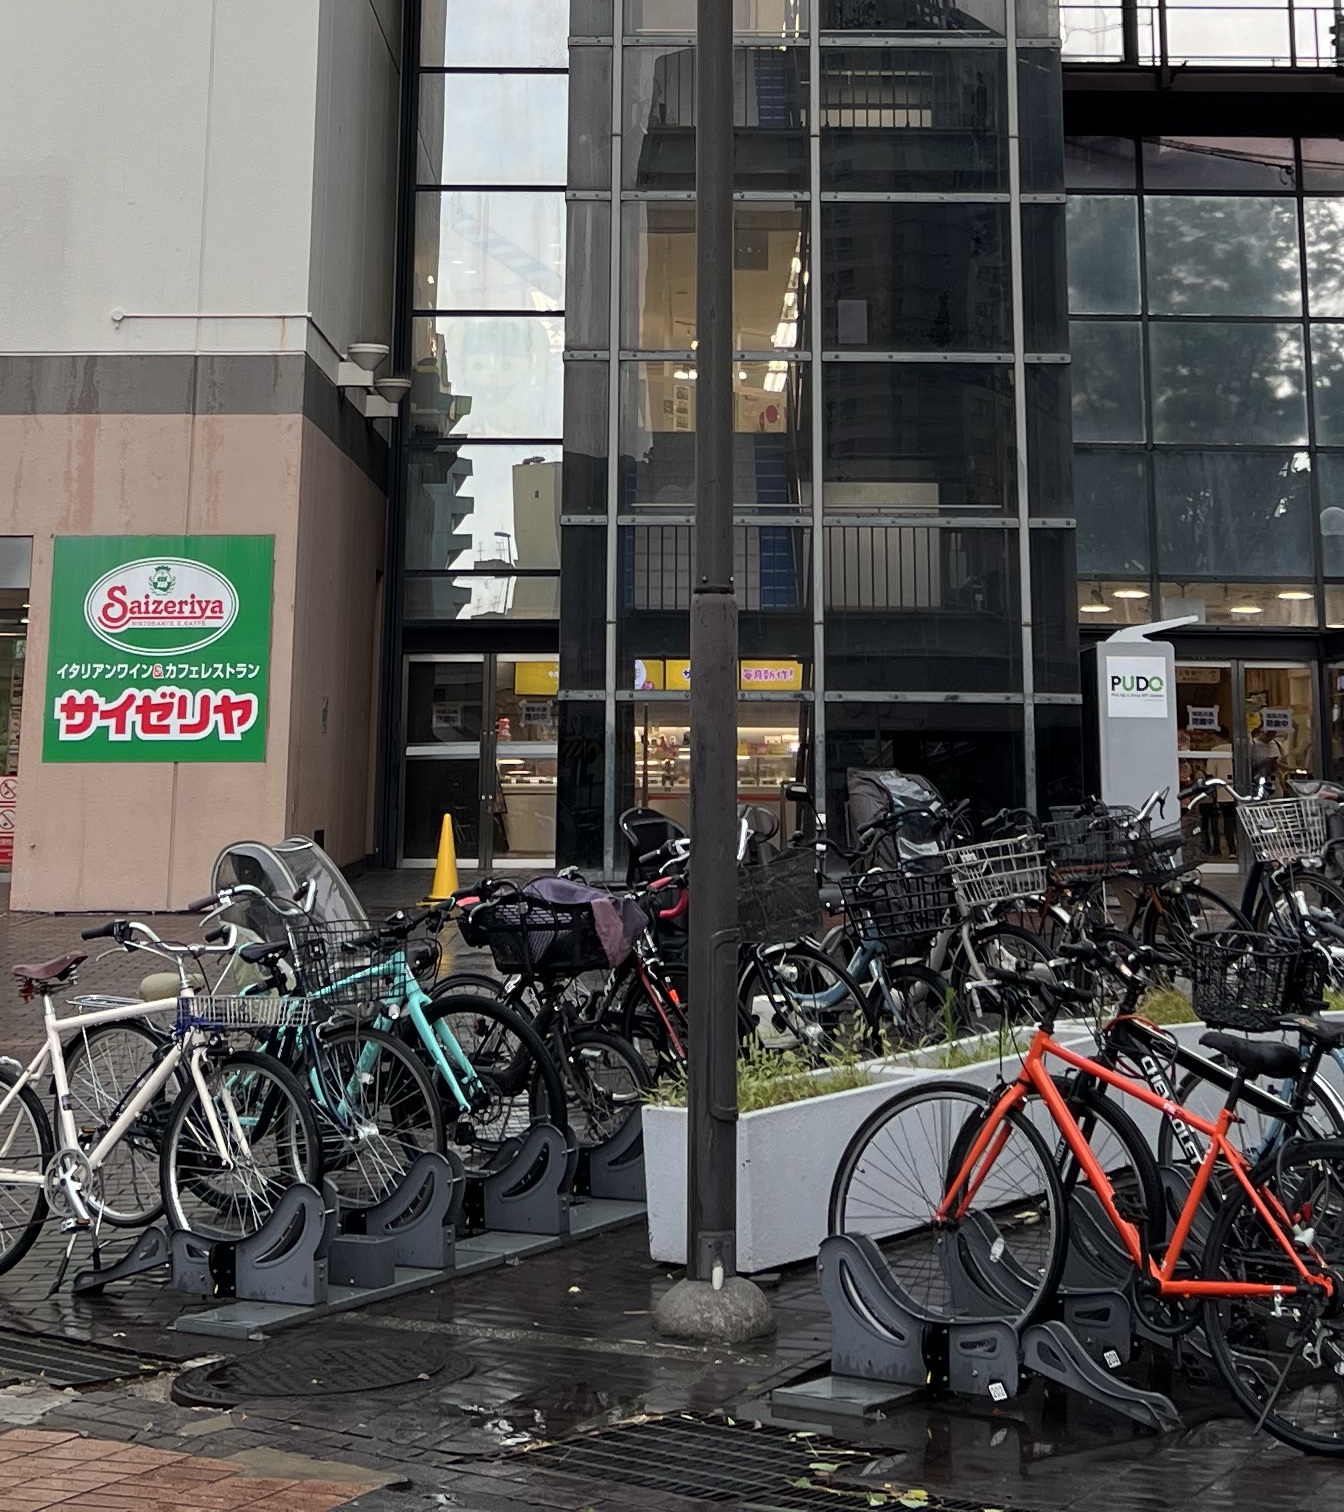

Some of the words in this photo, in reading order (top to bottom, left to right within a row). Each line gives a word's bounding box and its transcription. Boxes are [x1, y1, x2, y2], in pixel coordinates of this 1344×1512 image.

[99, 584, 225, 628] Saizeriya
[56, 663, 260, 680] イタリアンワイン&カフェレストラン
[1110, 675, 1165, 693] PUDO
[57, 689, 257, 738] サイゼリヤ
